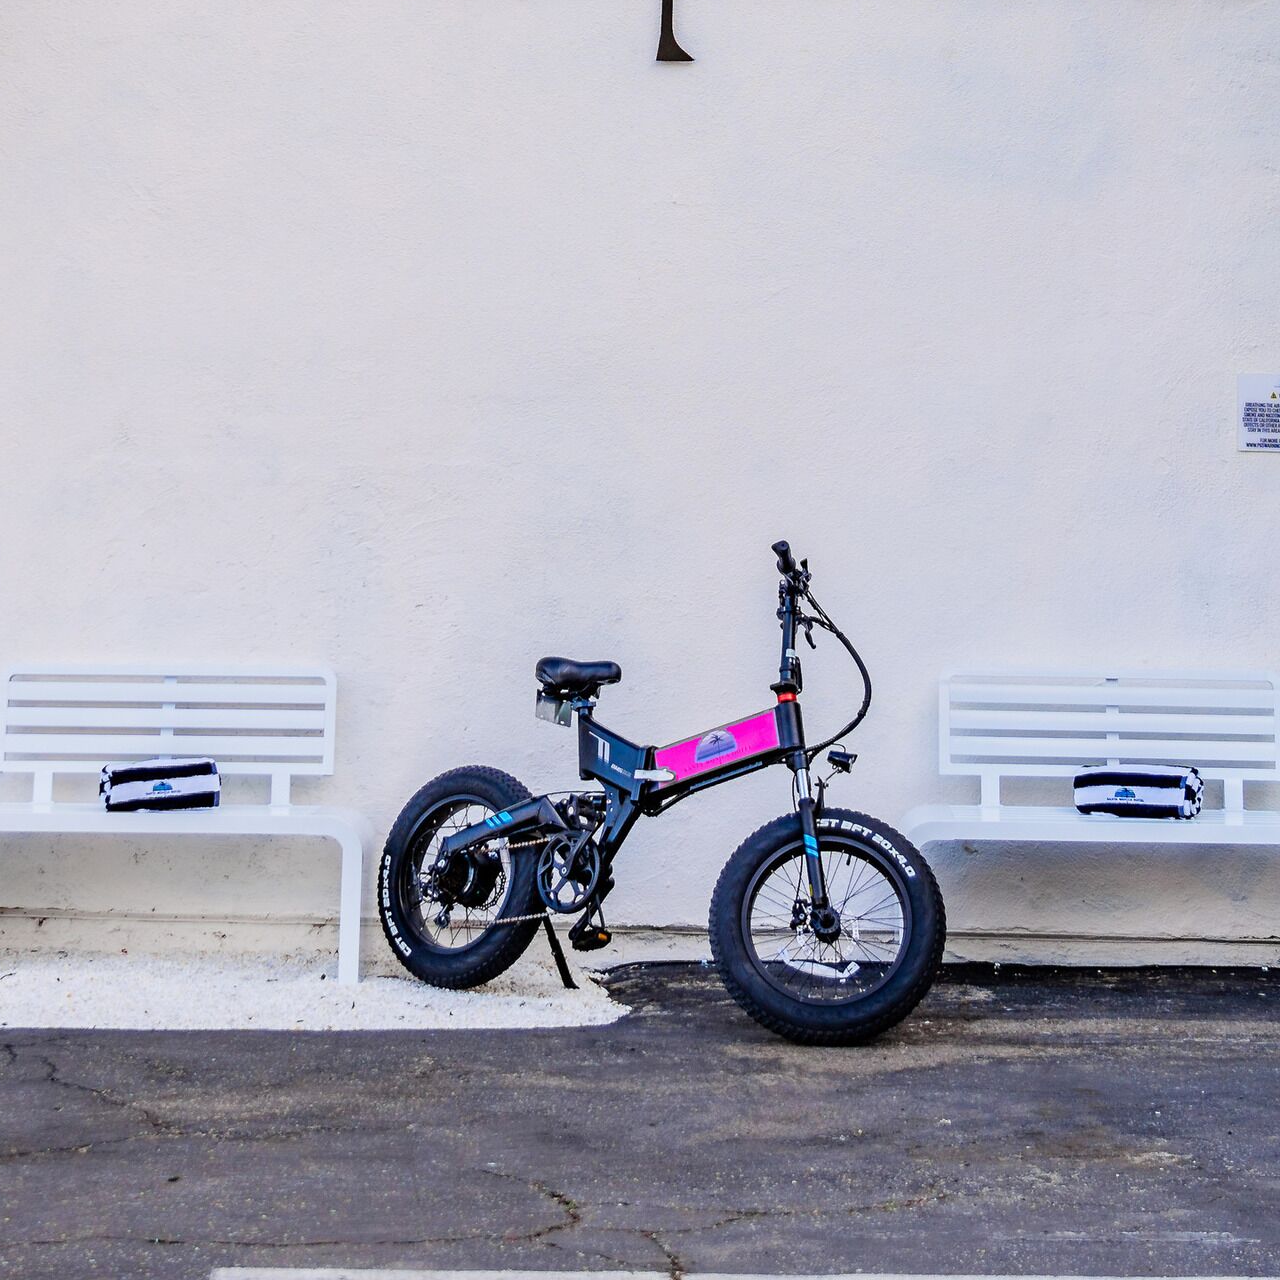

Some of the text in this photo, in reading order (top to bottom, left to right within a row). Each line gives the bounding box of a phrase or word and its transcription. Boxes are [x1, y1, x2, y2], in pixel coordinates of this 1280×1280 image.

[817, 819, 839, 828] ST
[841, 820, 872, 836] BFT
[395, 936, 412, 957] CST
